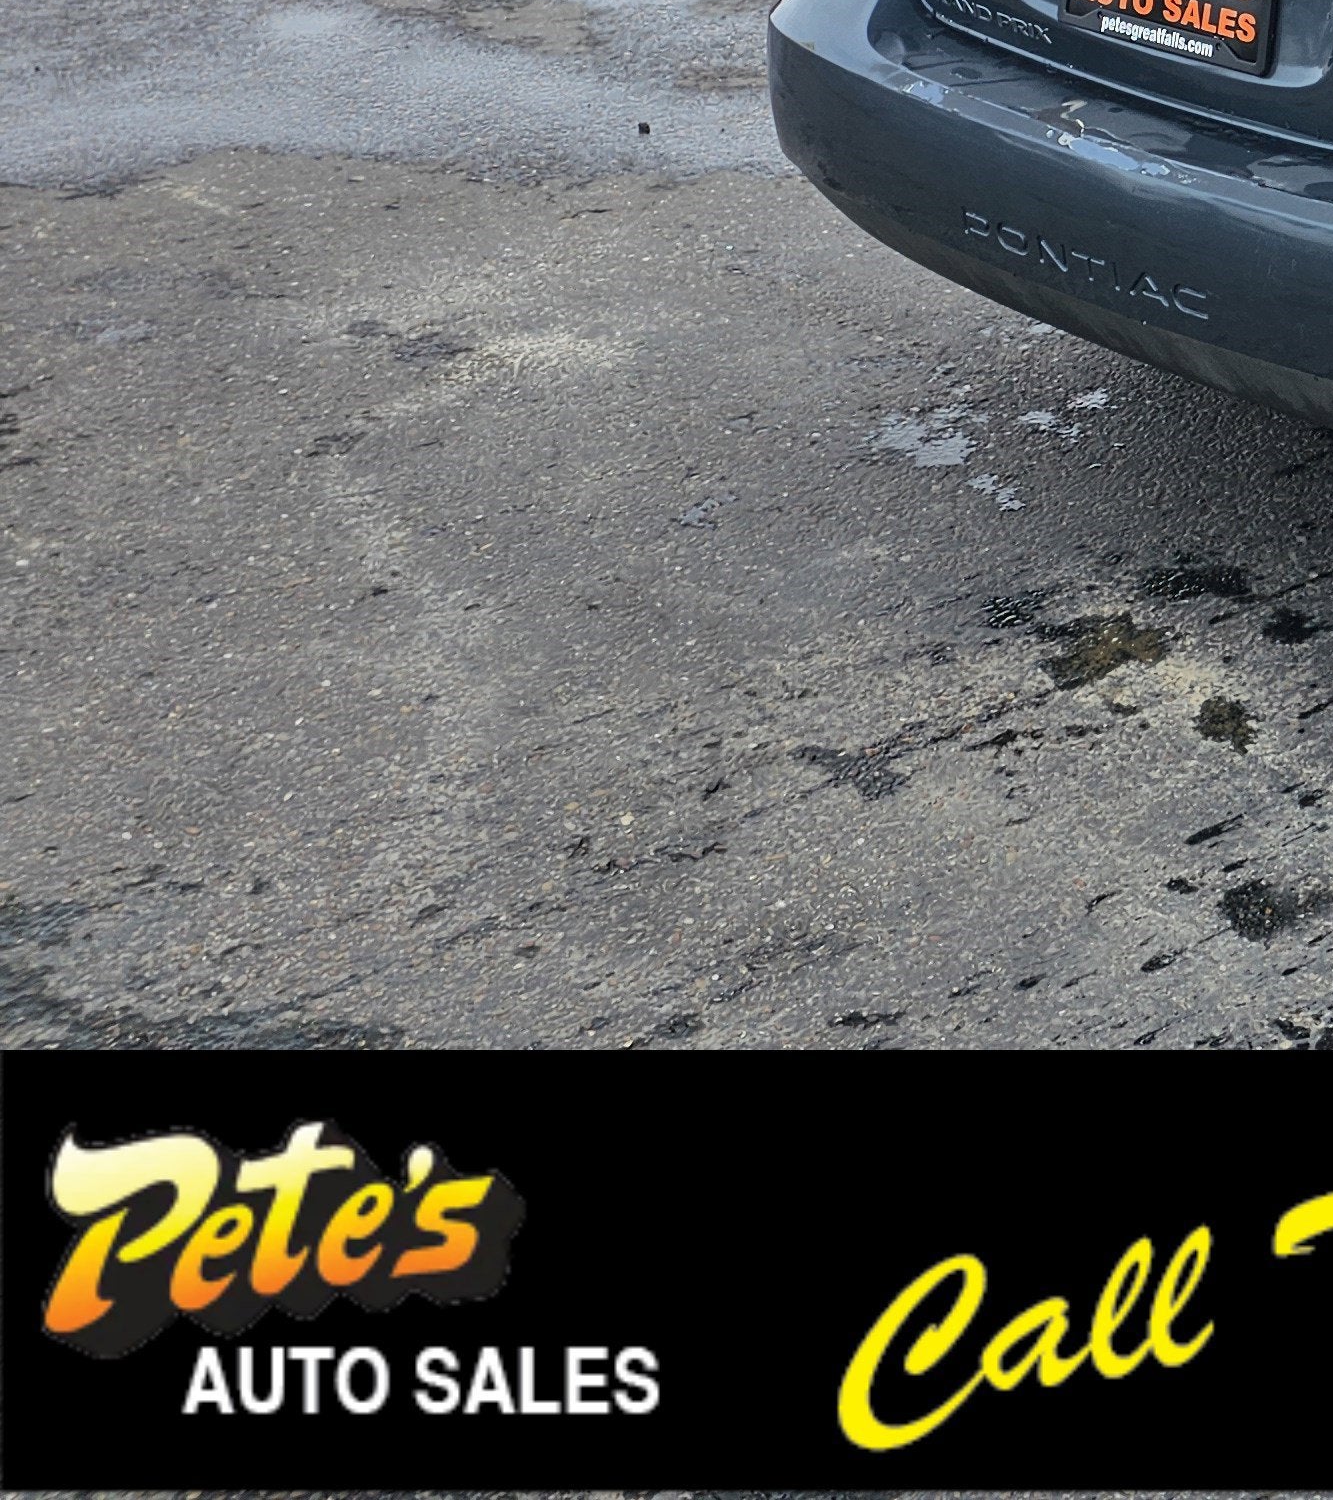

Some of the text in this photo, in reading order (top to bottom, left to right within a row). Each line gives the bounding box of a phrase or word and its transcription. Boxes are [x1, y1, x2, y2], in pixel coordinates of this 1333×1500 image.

[996, 11, 1053, 45] PRIX
[1100, 14, 1214, 58] petesgreatfalls.com
[960, 205, 1209, 320] PONTIAC
